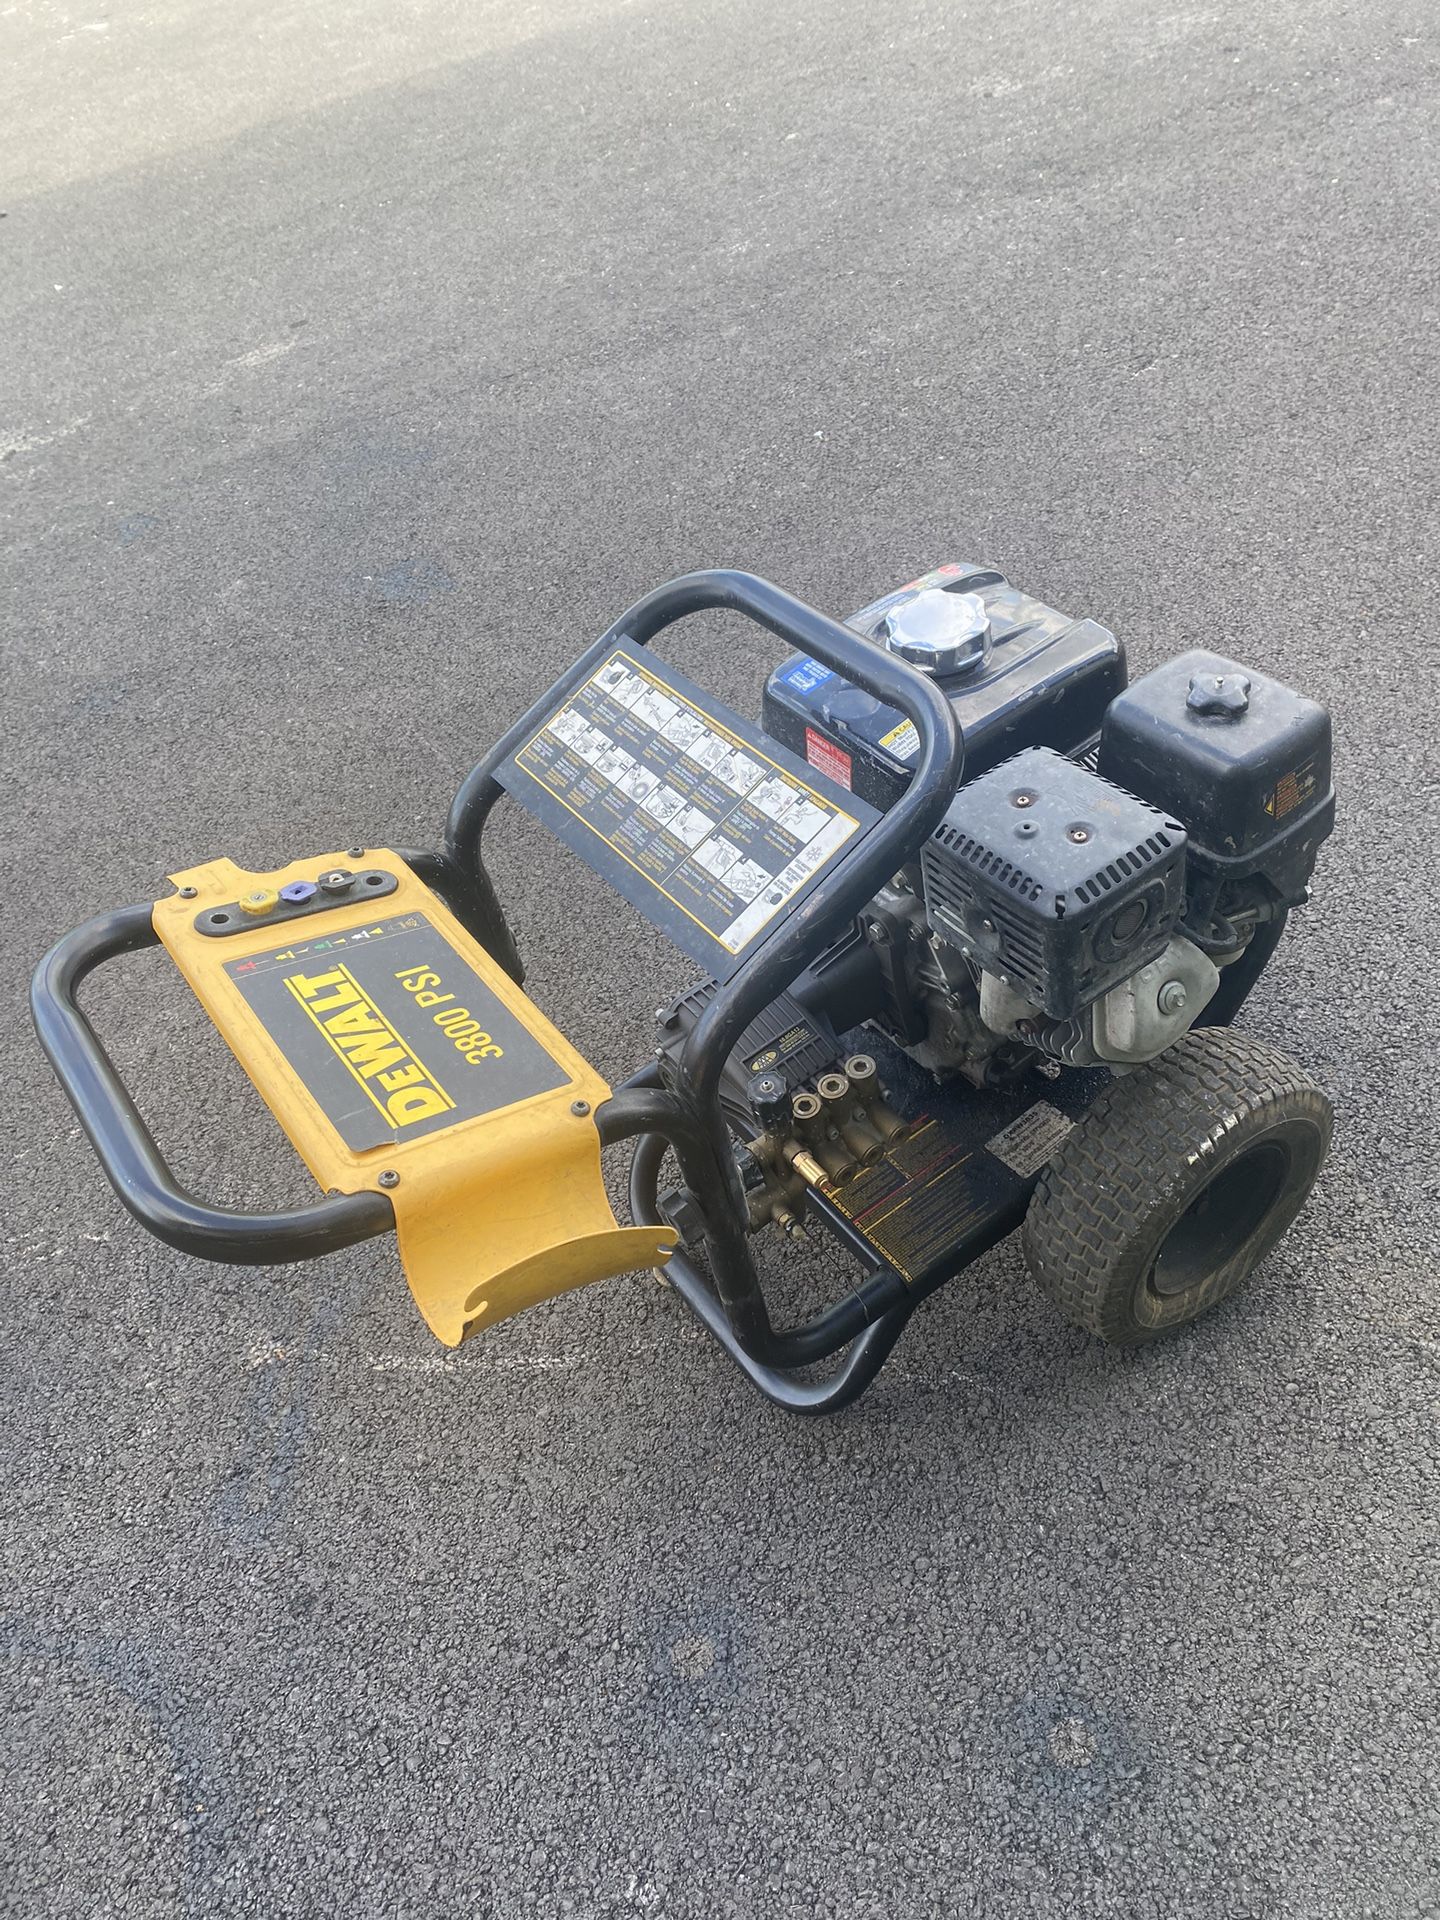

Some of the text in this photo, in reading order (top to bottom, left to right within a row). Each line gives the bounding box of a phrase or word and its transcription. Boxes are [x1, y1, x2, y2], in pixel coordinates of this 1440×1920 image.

[290, 970, 450, 1127] DEWALT
[394, 964, 504, 1065] 3800 PSI
